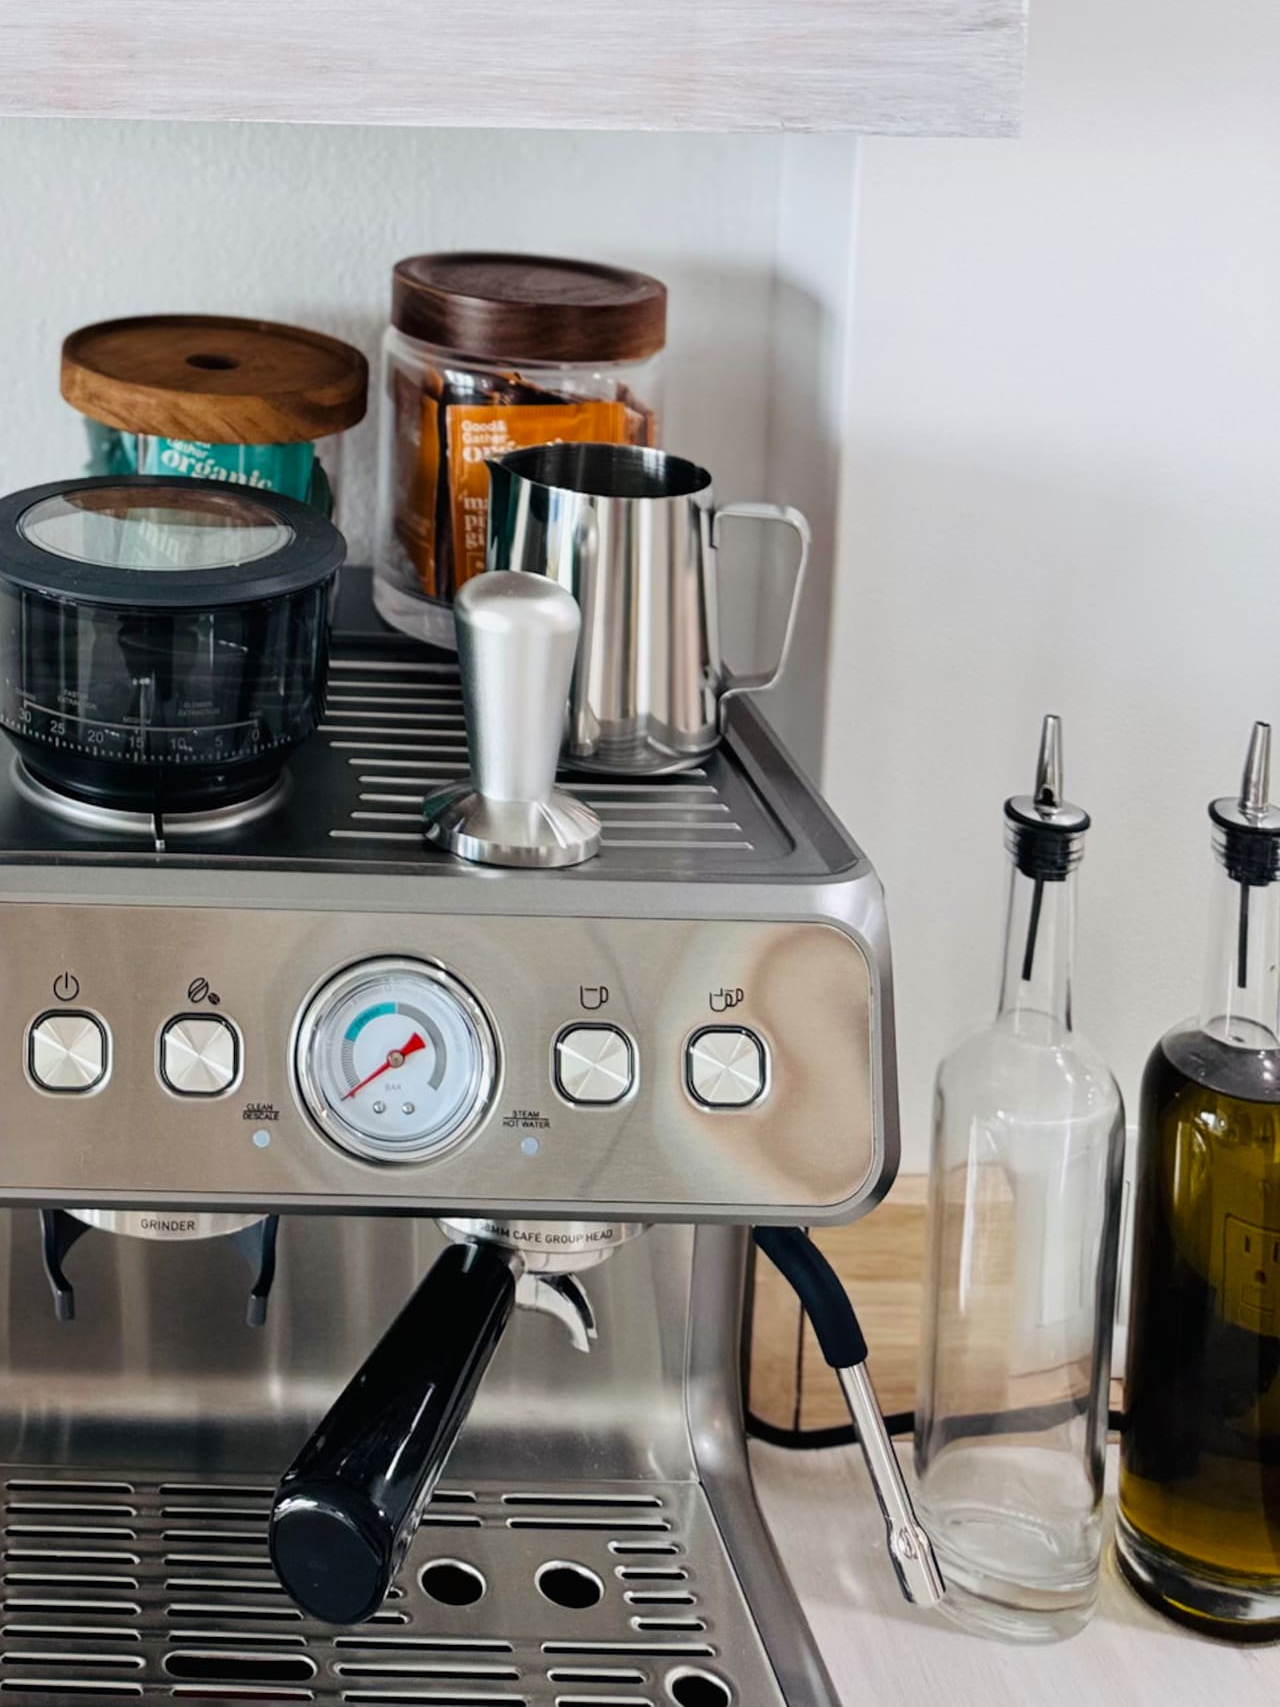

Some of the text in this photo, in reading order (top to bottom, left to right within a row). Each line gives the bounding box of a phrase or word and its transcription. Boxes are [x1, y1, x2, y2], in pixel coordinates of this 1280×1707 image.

[19, 708, 260, 750] 30 25 20 15 10 5 0
[243, 1111, 280, 1120] DESCALE
[512, 1110, 540, 1118] STEAM
[503, 1120, 551, 1129] HOT WATER
[140, 1218, 196, 1231] GRINDER
[512, 1229, 542, 1242] CAFÉ
[544, 1234, 584, 1244] GROUP
[585, 1229, 614, 1242] HEAD
